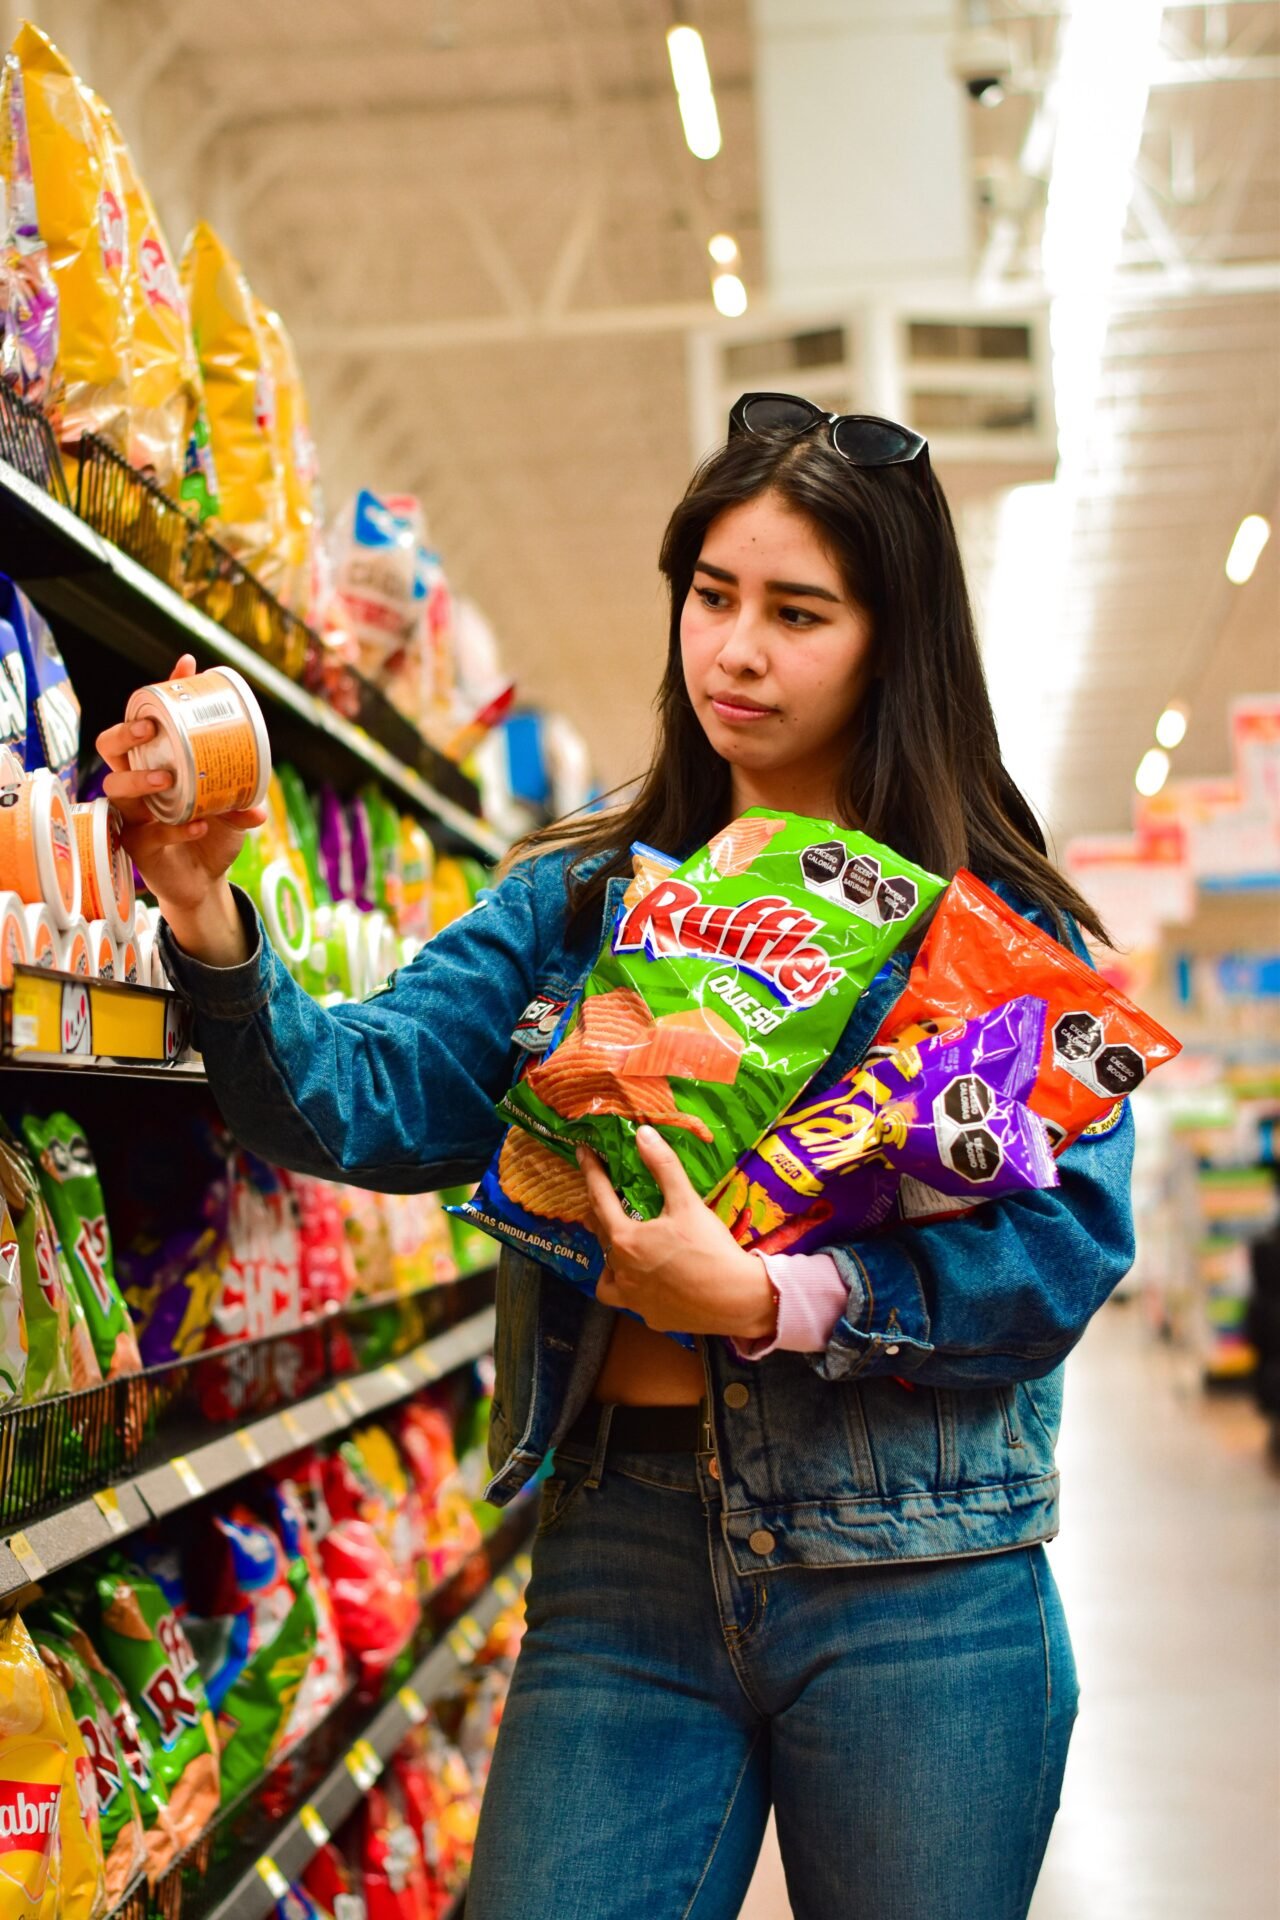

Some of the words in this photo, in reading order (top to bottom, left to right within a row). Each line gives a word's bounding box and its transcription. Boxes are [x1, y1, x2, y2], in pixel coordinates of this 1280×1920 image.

[814, 848, 838, 864] EXCESO
[853, 864, 873, 879] EXCESO
[613, 879, 847, 1008] Ruffles
[707, 974, 782, 1036] QUESO
[1106, 1064, 1128, 1082] SODIO
[1109, 1056, 1135, 1077] EXCESO
[771, 1152, 803, 1180] FUEGO
[497, 1221, 553, 1252] ONDULADAS
[553, 1244, 575, 1260] CON
[575, 1252, 591, 1271] SAL
